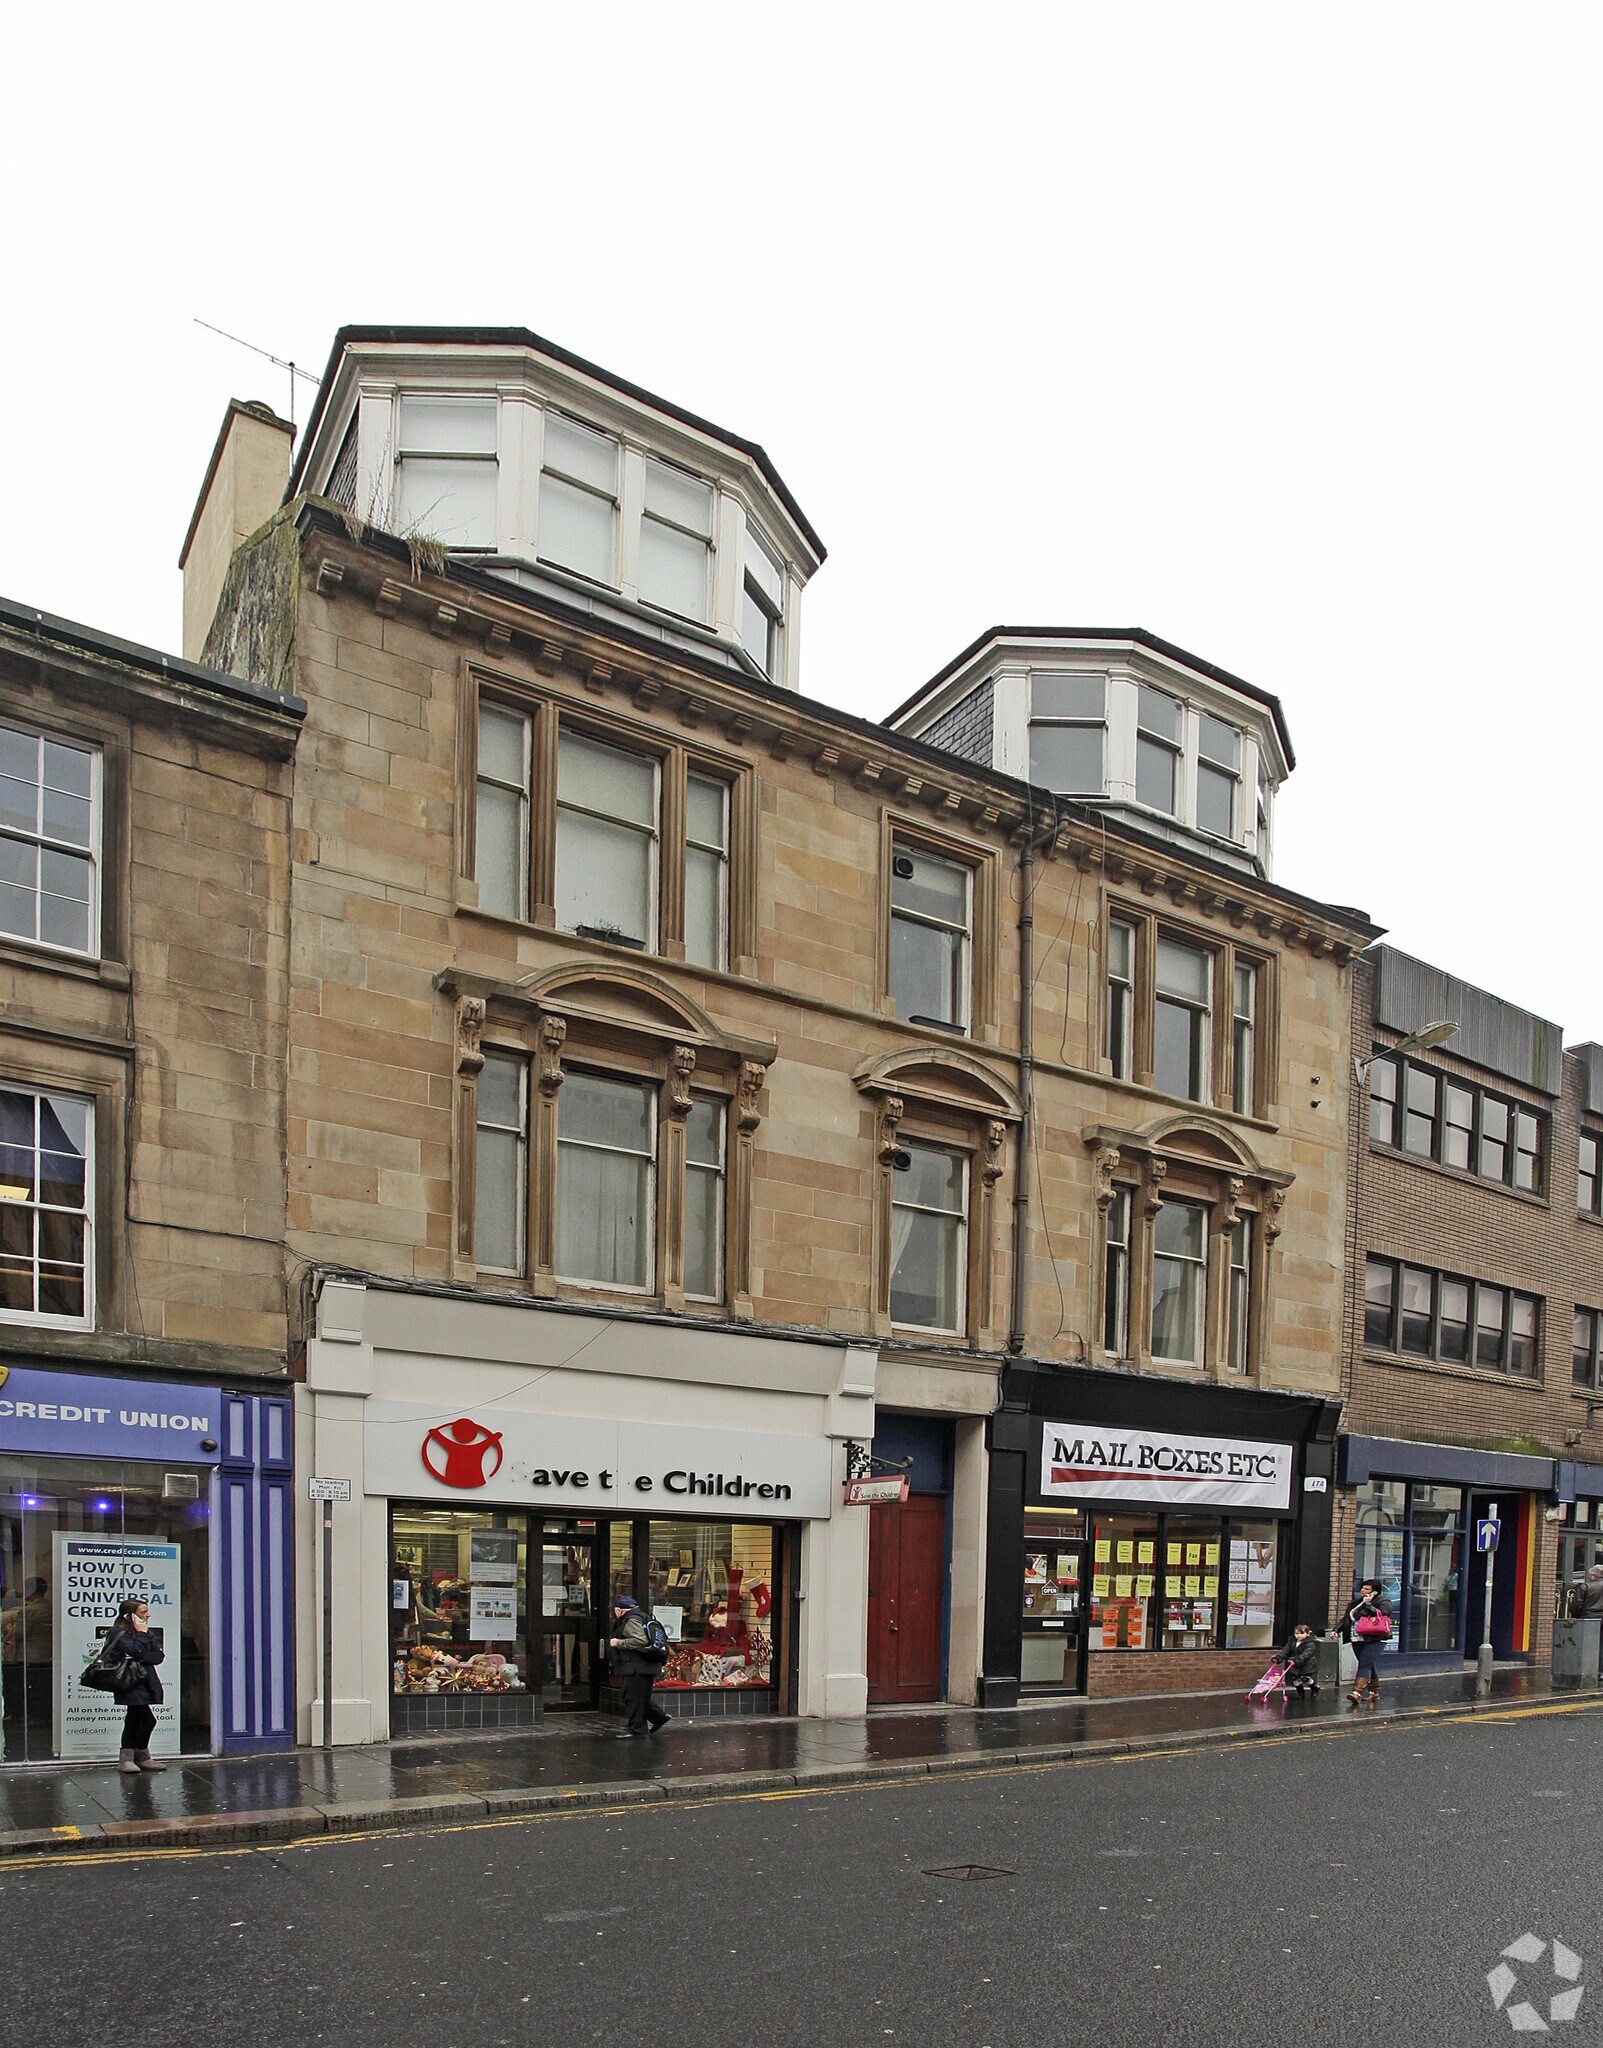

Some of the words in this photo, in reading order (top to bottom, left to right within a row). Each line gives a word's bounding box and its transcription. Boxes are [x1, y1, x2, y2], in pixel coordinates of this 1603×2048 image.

[119, 1410, 209, 1432] UNION
[1051, 1437, 1133, 1468] MAIL
[1137, 1444, 1223, 1474] BOXES
[663, 1471, 792, 1499] Children
[78, 1547, 167, 1557] www.credEcard.com
[68, 1561, 115, 1574] HOW
[119, 1563, 144, 1575] TO
[68, 1576, 148, 1589] SURVIVE
